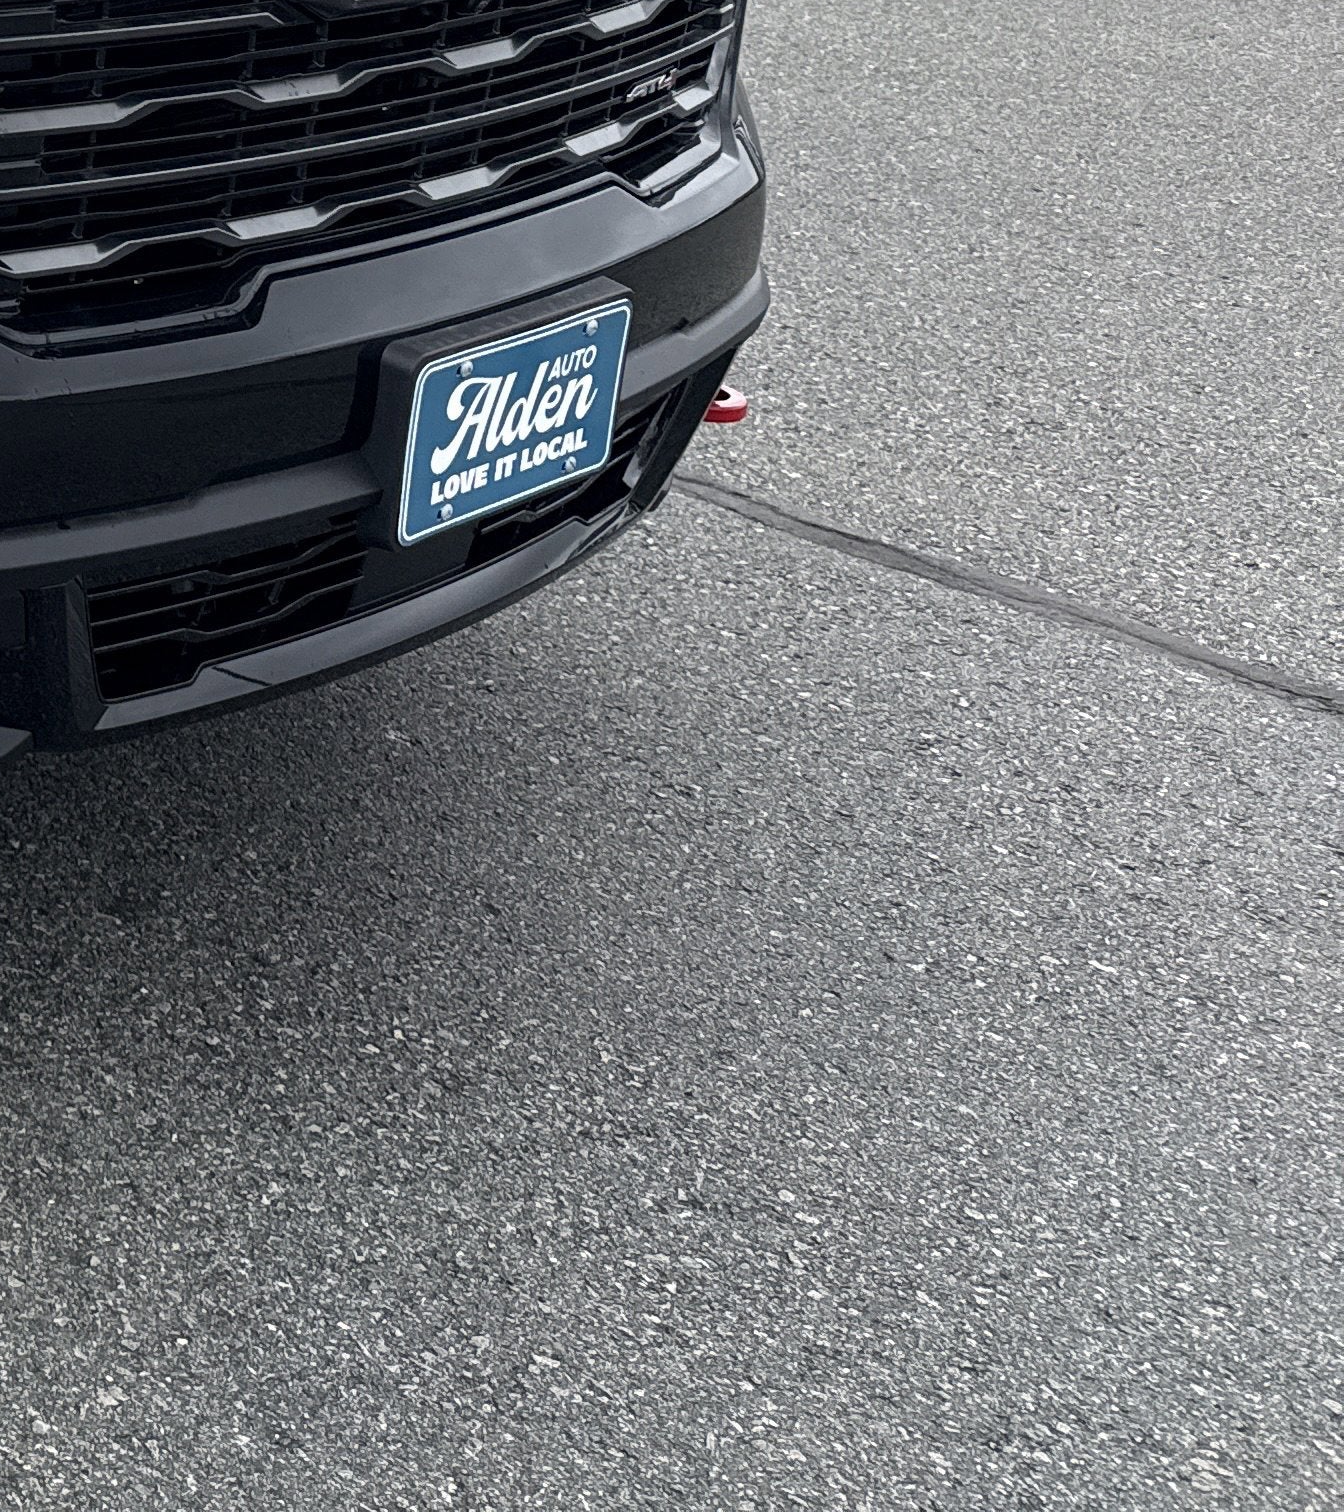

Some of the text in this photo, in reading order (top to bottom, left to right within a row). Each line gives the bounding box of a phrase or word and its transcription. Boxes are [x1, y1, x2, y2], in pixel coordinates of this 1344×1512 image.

[547, 344, 598, 382] AUTO
[430, 360, 599, 475] Alden
[430, 428, 588, 506] LOVE IT LOCAL
